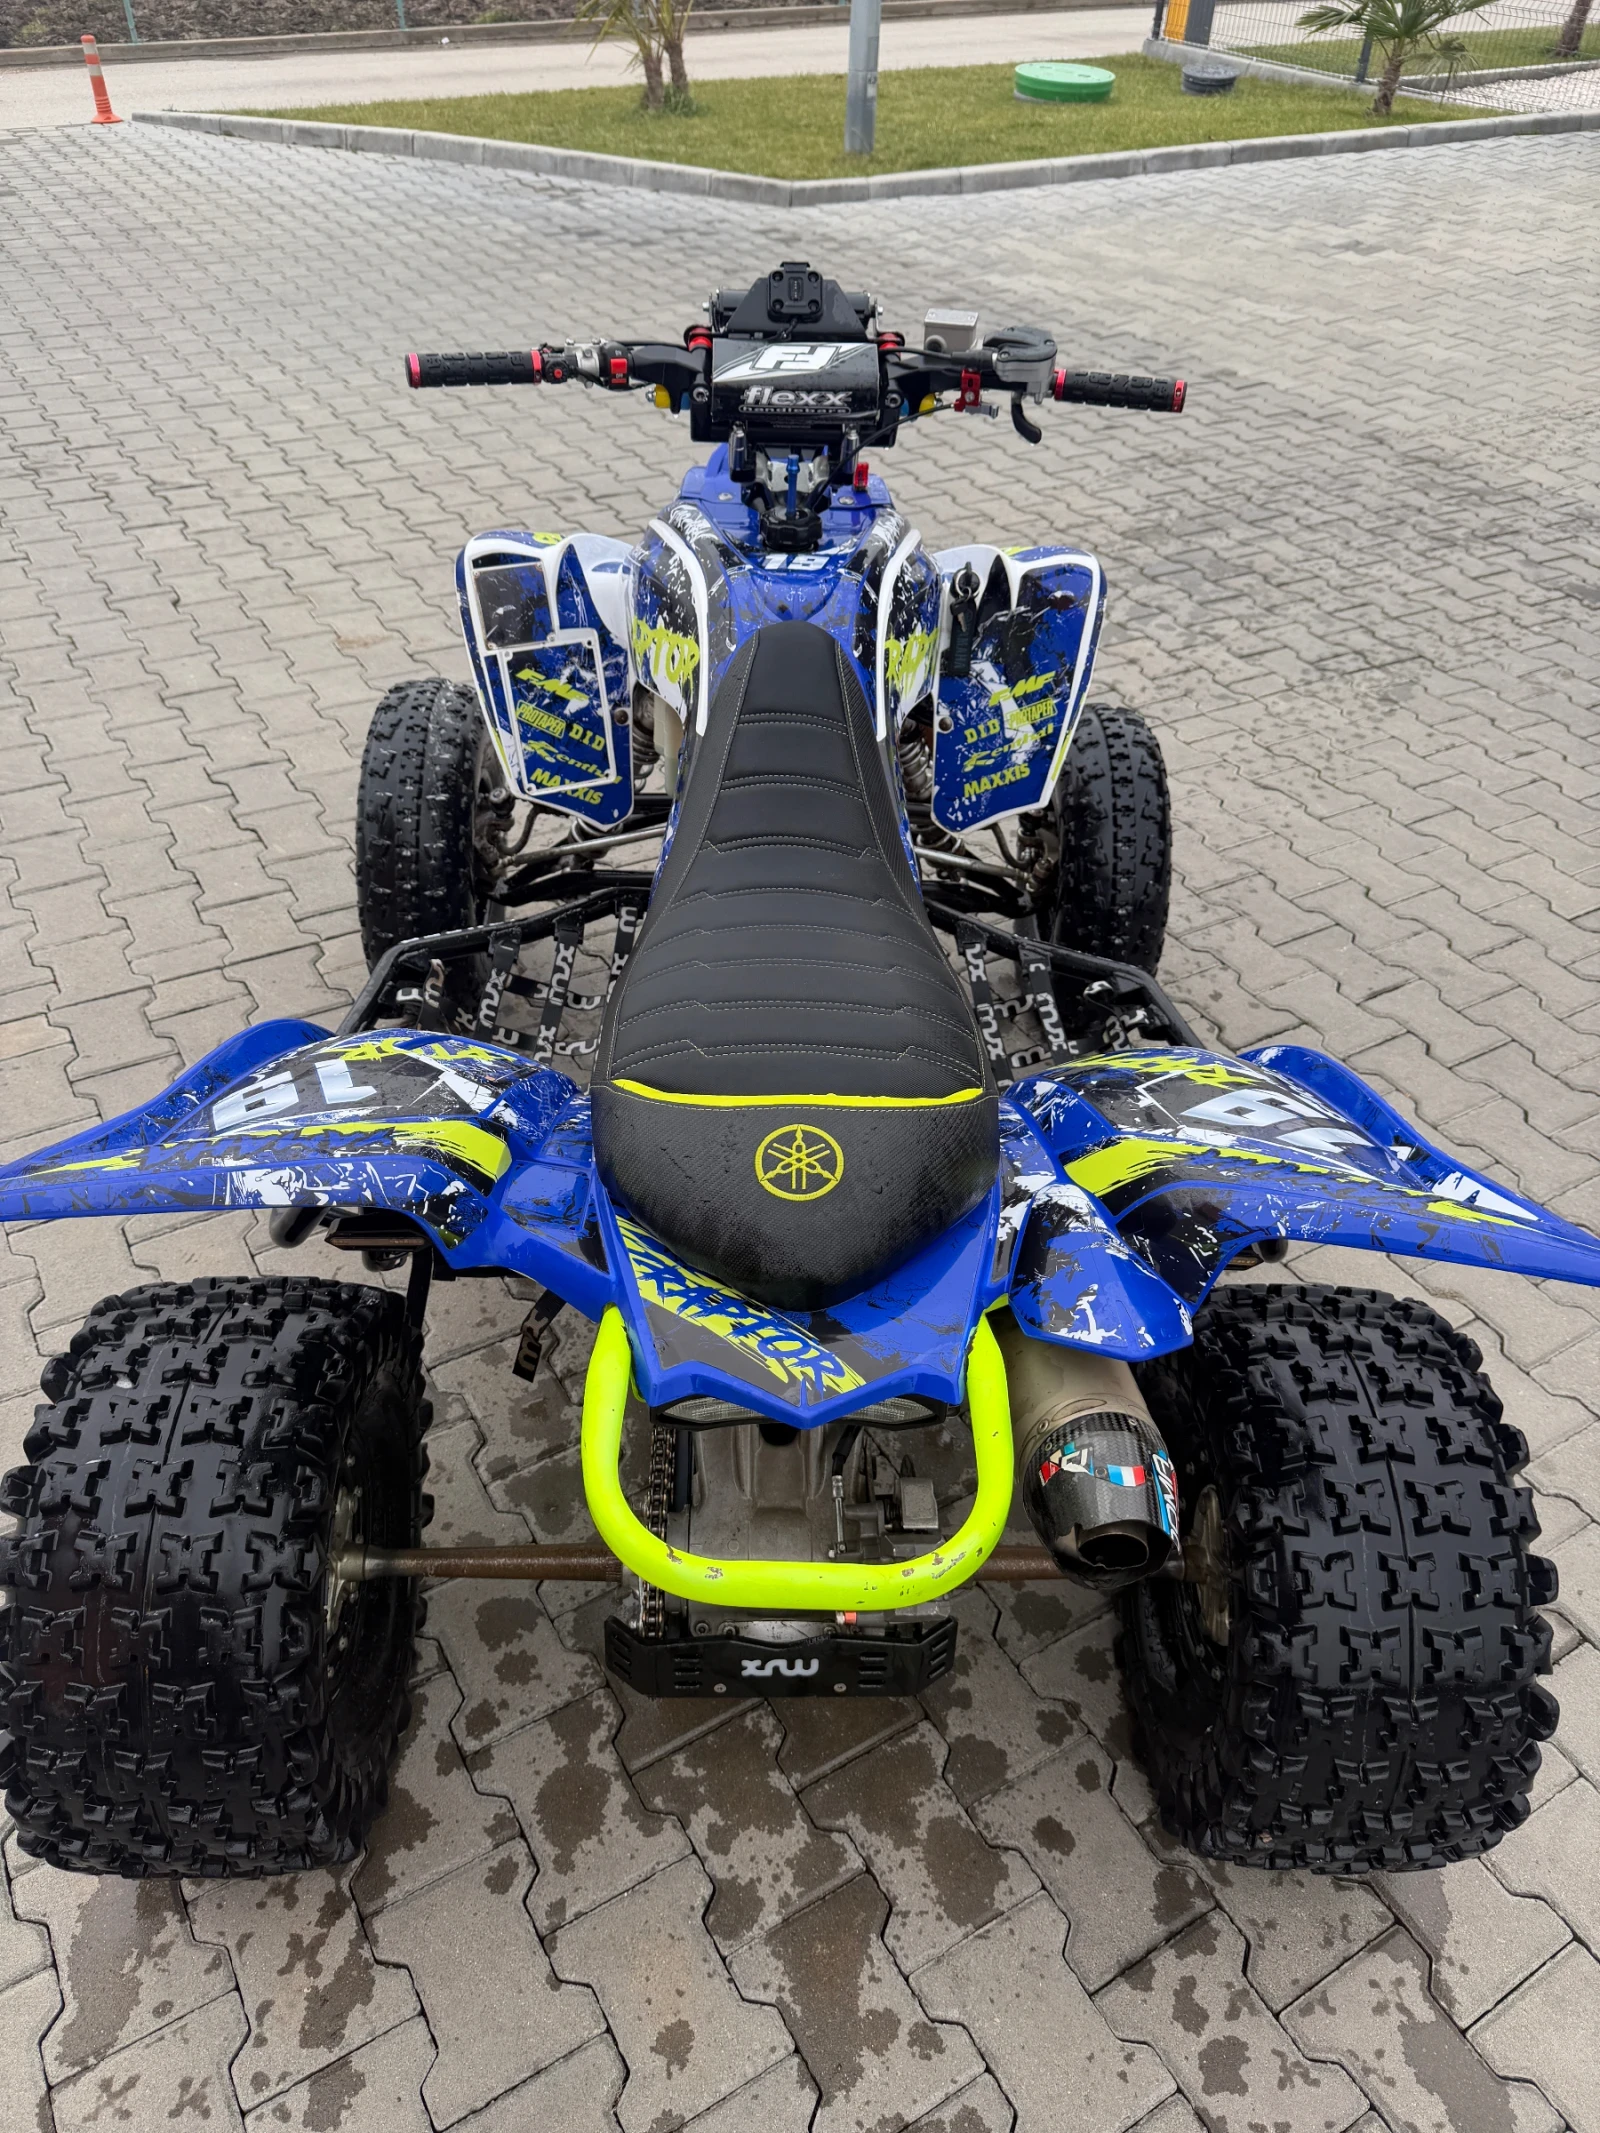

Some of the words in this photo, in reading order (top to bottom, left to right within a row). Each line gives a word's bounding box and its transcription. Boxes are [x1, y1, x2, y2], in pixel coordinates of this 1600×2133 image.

[740, 384, 852, 406] flexx
[762, 553, 830, 571] 19
[989, 671, 1056, 707] FMF
[964, 763, 1031, 798] MAXXIS
[632, 1255, 846, 1392] RAPTOR
